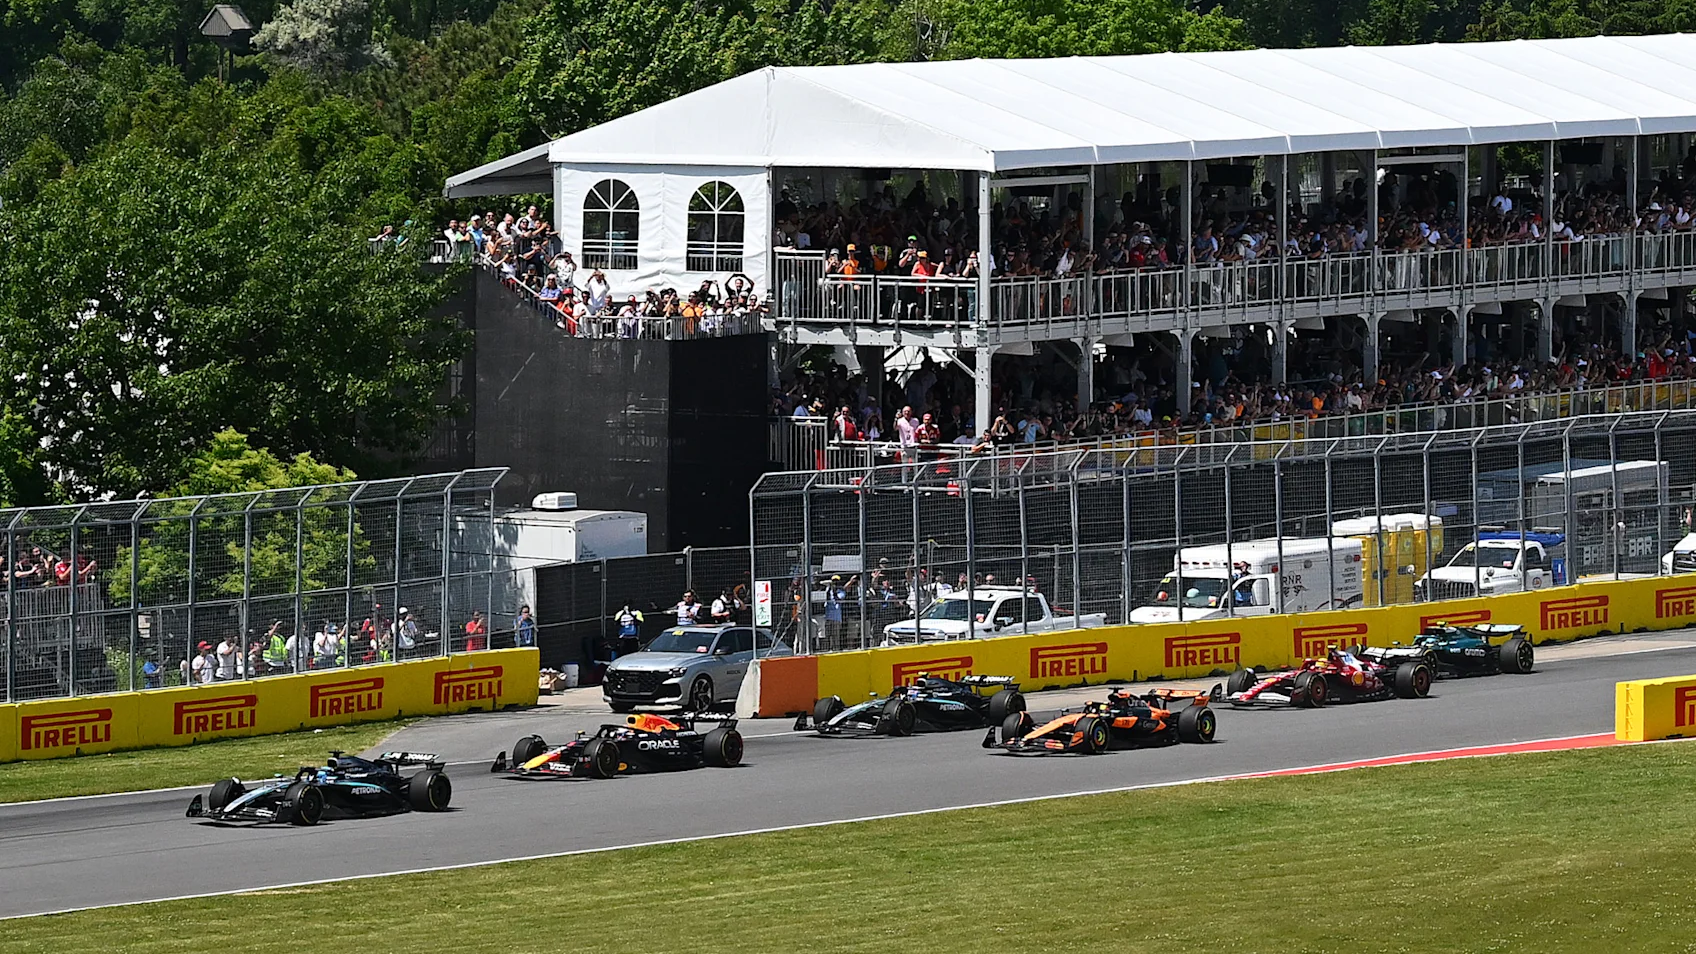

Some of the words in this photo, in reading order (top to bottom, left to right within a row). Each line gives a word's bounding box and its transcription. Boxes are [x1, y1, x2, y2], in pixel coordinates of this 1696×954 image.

[1628, 536, 1653, 558] BAR
[1541, 595, 1609, 630] PIRELLI
[1030, 642, 1108, 678] PIRELLI
[1164, 632, 1240, 667] PIRELLI
[310, 677, 384, 717] PIRELLI
[434, 666, 503, 704] PIRELLI
[22, 708, 113, 750] PIRELLI
[174, 694, 257, 735] PIRELLI
[638, 739, 681, 751] ORACLE
